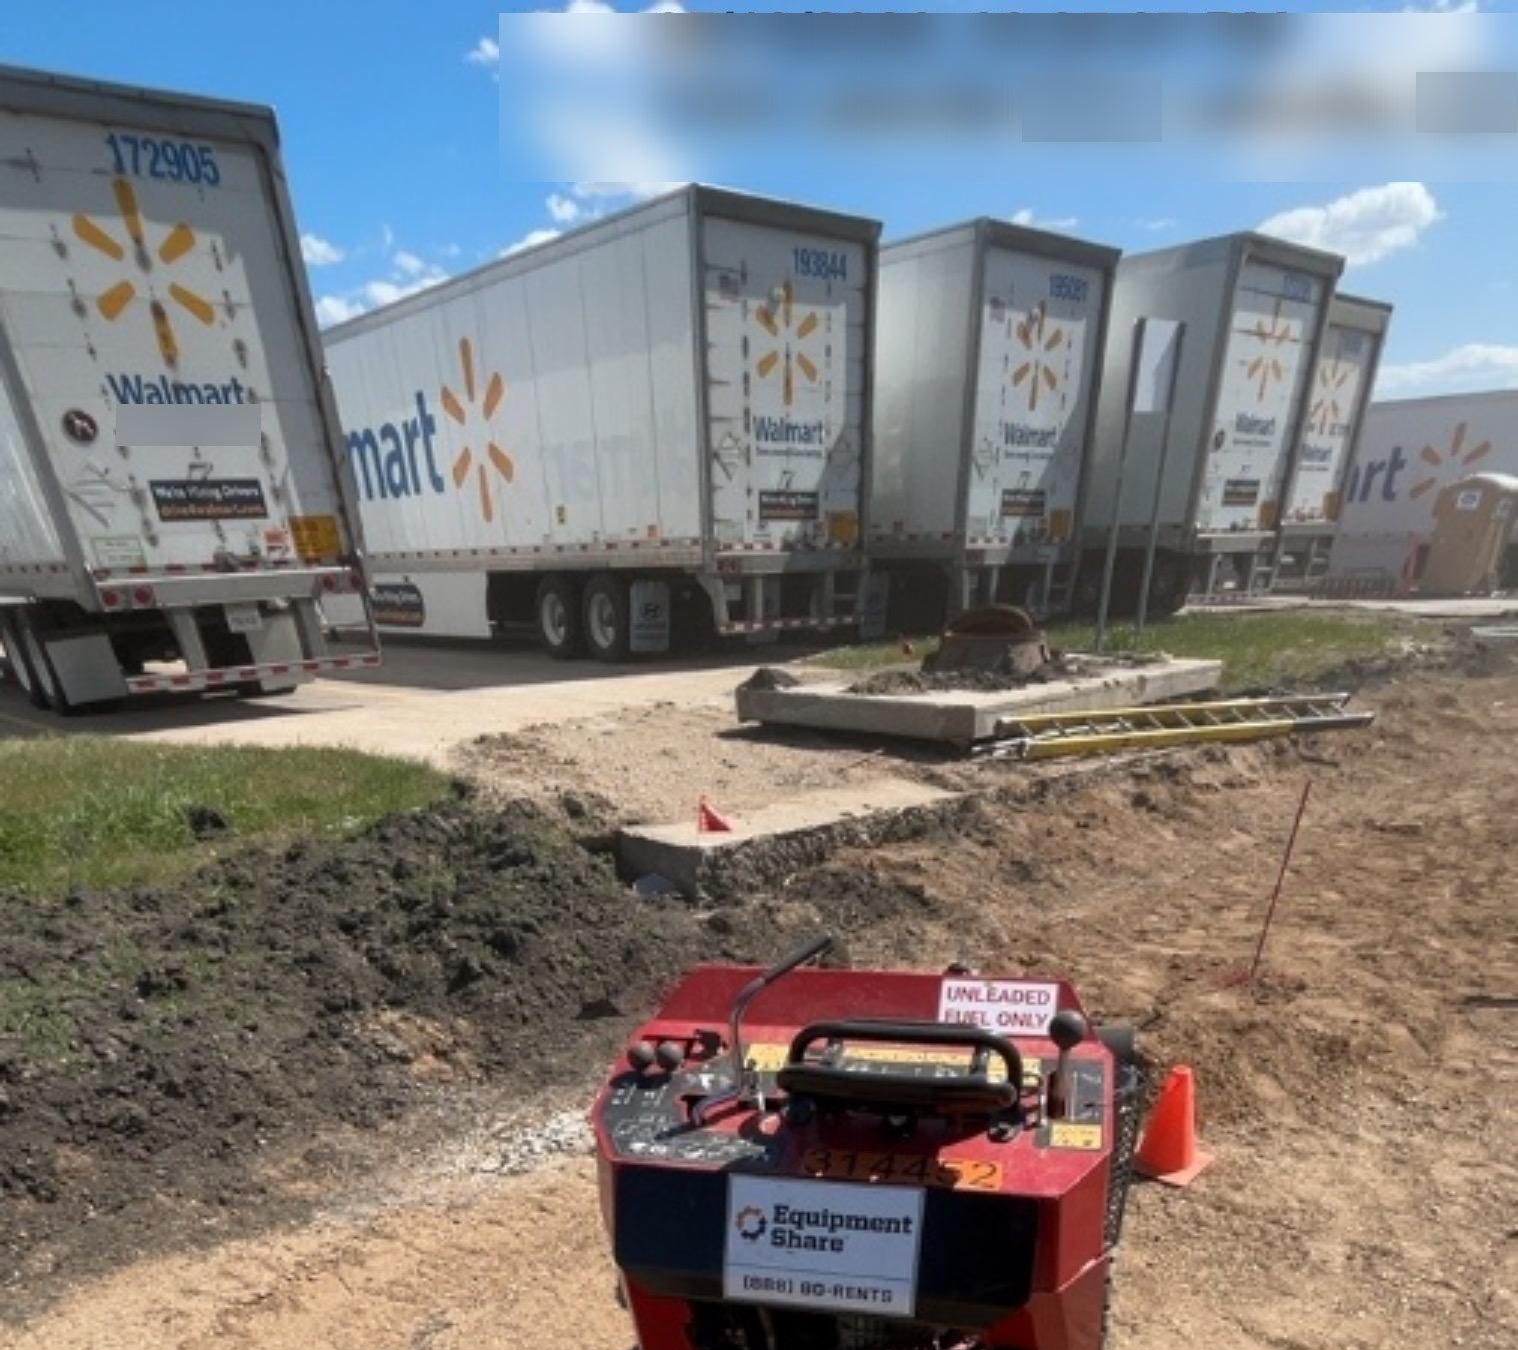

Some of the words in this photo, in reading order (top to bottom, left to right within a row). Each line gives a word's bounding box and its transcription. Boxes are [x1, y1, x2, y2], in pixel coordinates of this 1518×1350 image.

[105, 132, 220, 187] 172905
[794, 247, 847, 281] 193844
[106, 373, 244, 404] Walmart
[753, 416, 824, 444] Walmart
[1004, 422, 1057, 449] Walmart
[946, 985, 1051, 1006] UNLEADED
[944, 1009, 990, 1026] FUEL
[996, 1010, 1049, 1027] ONLY
[804, 1150, 999, 1189] 314452
[772, 1204, 913, 1233] Equipment
[770, 1227, 845, 1252] Share
